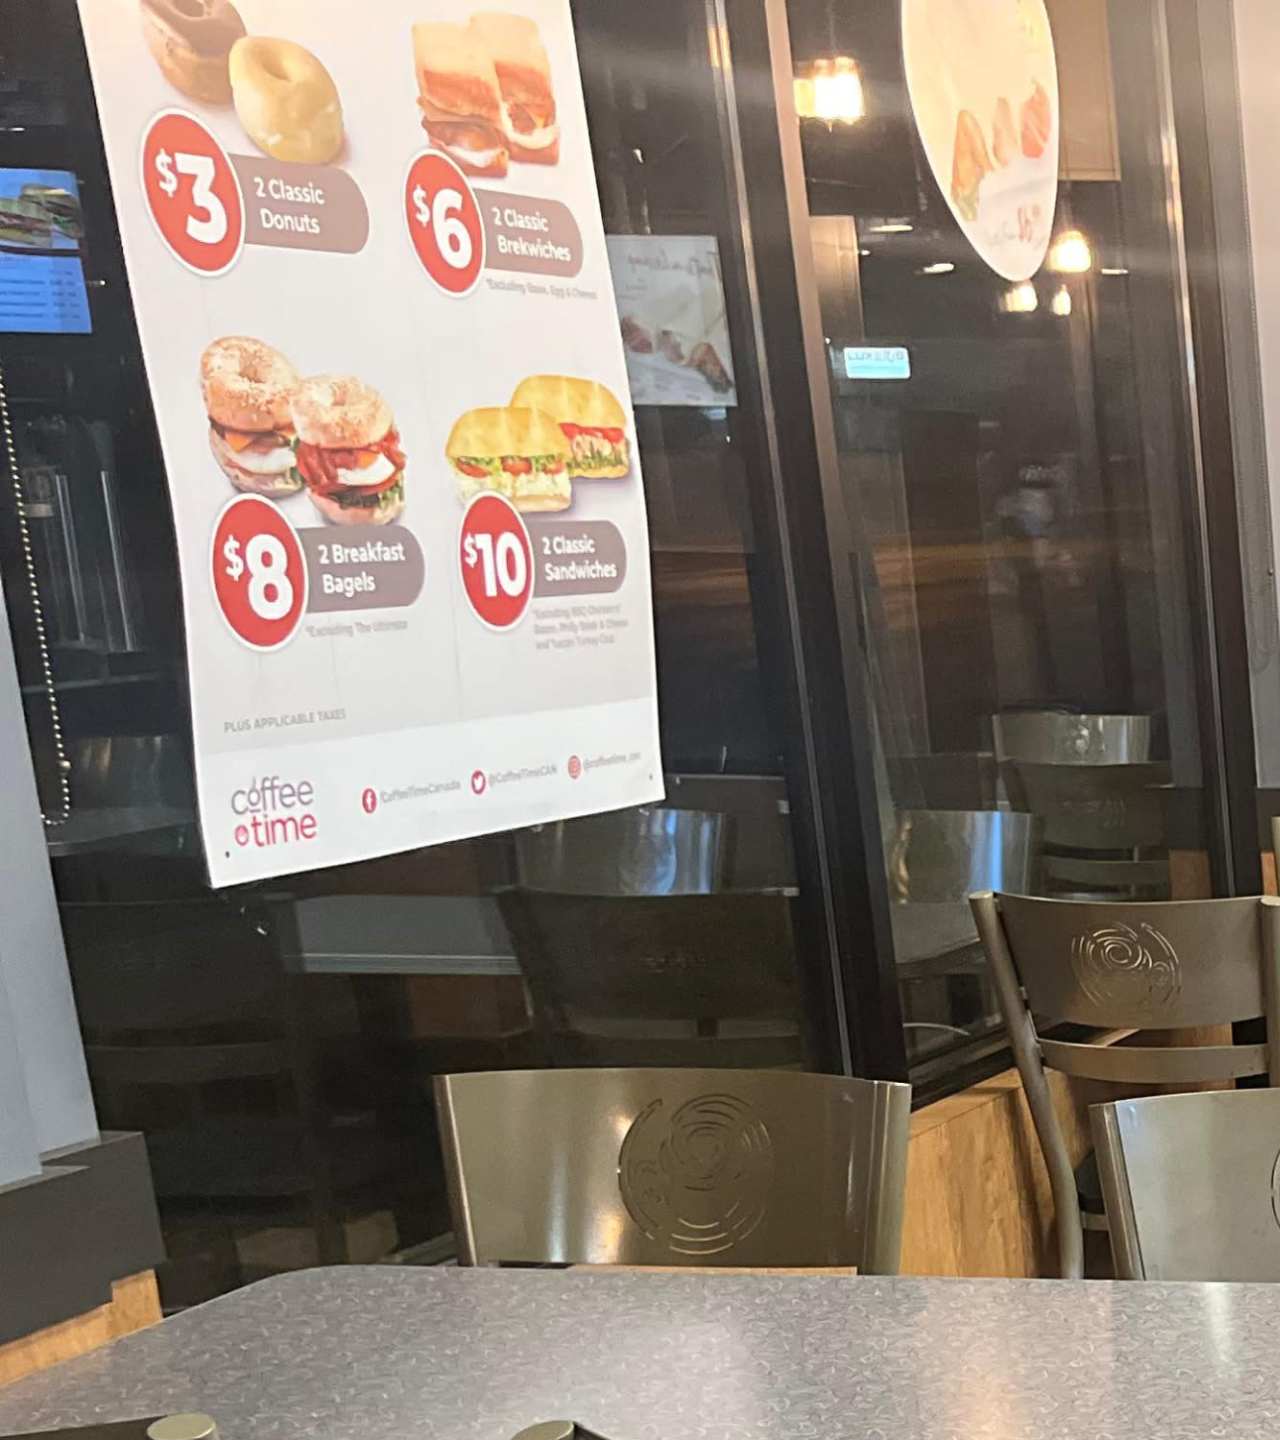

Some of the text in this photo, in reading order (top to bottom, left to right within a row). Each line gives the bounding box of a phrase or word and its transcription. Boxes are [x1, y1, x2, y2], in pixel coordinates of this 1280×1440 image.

[155, 148, 228, 244] $3
[253, 177, 325, 205] 2 Classic
[260, 207, 321, 234] Donuts
[412, 184, 473, 269] $6
[491, 208, 550, 233] 2 Classic
[496, 234, 571, 262] Brekwiches
[318, 541, 406, 564] 2 Breakfast
[542, 534, 596, 555] 2 Classic
[222, 534, 293, 620] $8
[464, 531, 527, 597] $10
[544, 559, 618, 582] Sandwiches
[322, 571, 376, 597] Bagels
[224, 707, 347, 733] PLUS APPLICABLE TAXES
[231, 775, 315, 815] coffee
[251, 813, 317, 848] time
